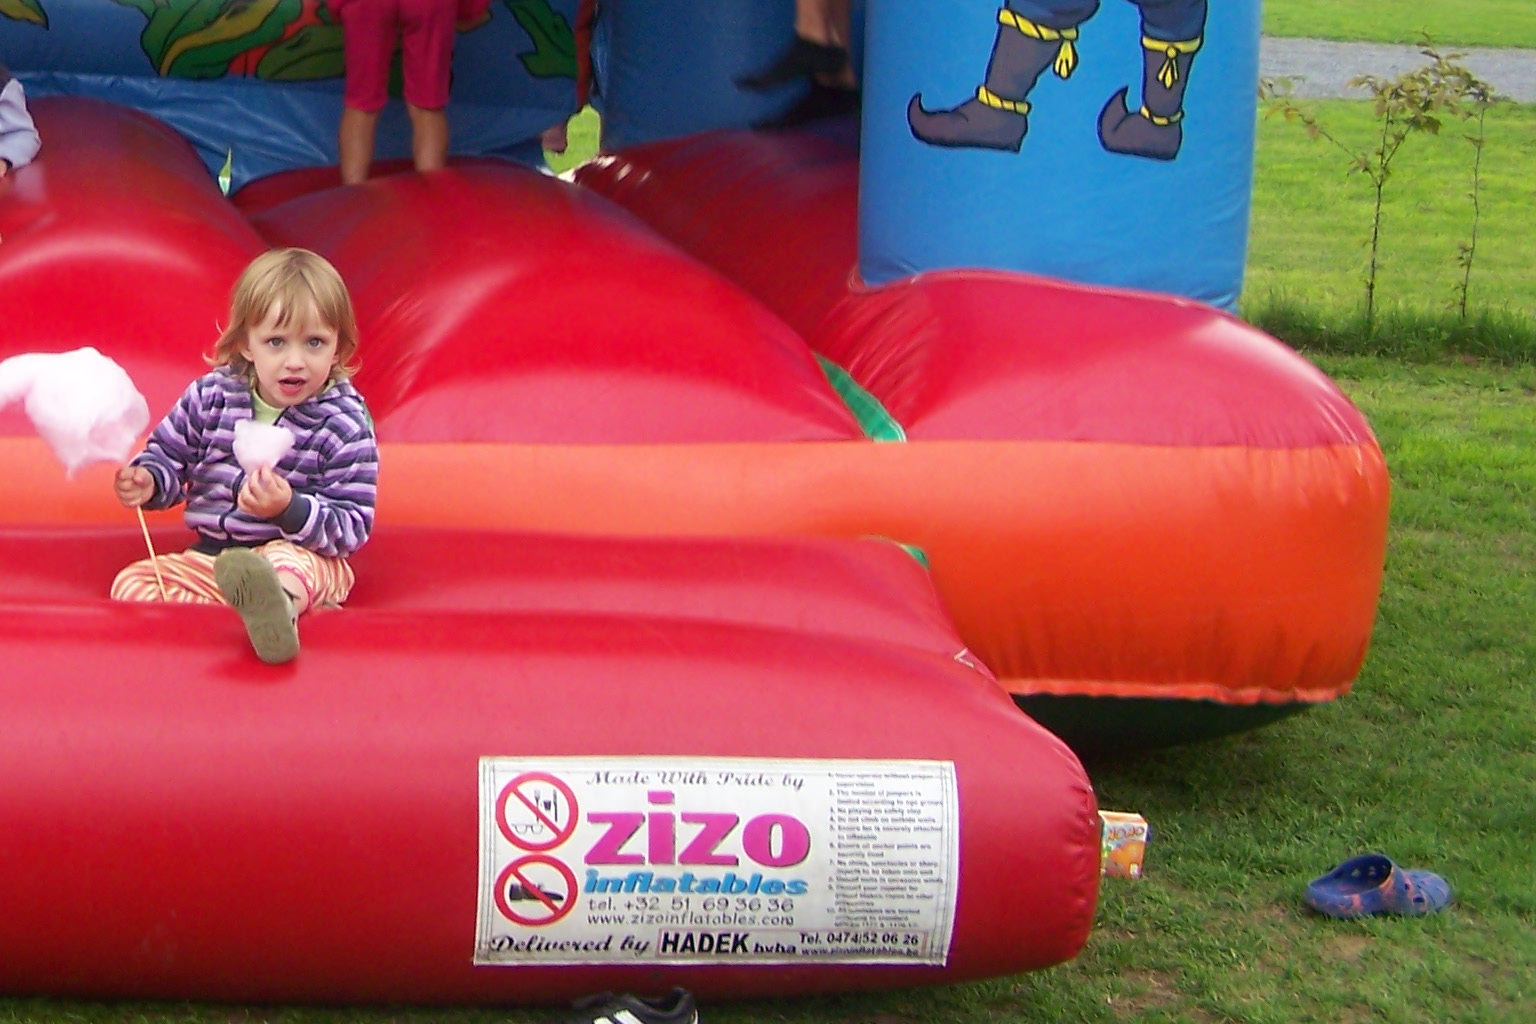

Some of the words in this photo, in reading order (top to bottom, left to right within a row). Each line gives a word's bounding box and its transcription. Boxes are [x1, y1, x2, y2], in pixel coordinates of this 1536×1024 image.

[586, 771, 650, 785] Made
[657, 771, 709, 785] With
[717, 772, 774, 786] Pride
[781, 773, 805, 791] by
[583, 790, 811, 868] zizo
[583, 868, 809, 896] inflatables
[624, 897, 660, 912] +32
[671, 898, 690, 911] 51
[702, 897, 729, 912] 69
[735, 897, 762, 912] 36
[767, 898, 794, 912] 36
[587, 911, 794, 926] www.zizoinflatables.com
[490, 935, 613, 952] Delivered
[620, 934, 651, 957] by
[663, 931, 750, 954] HADEK
[882, 932, 898, 945] 06
[903, 933, 919, 946] 26
